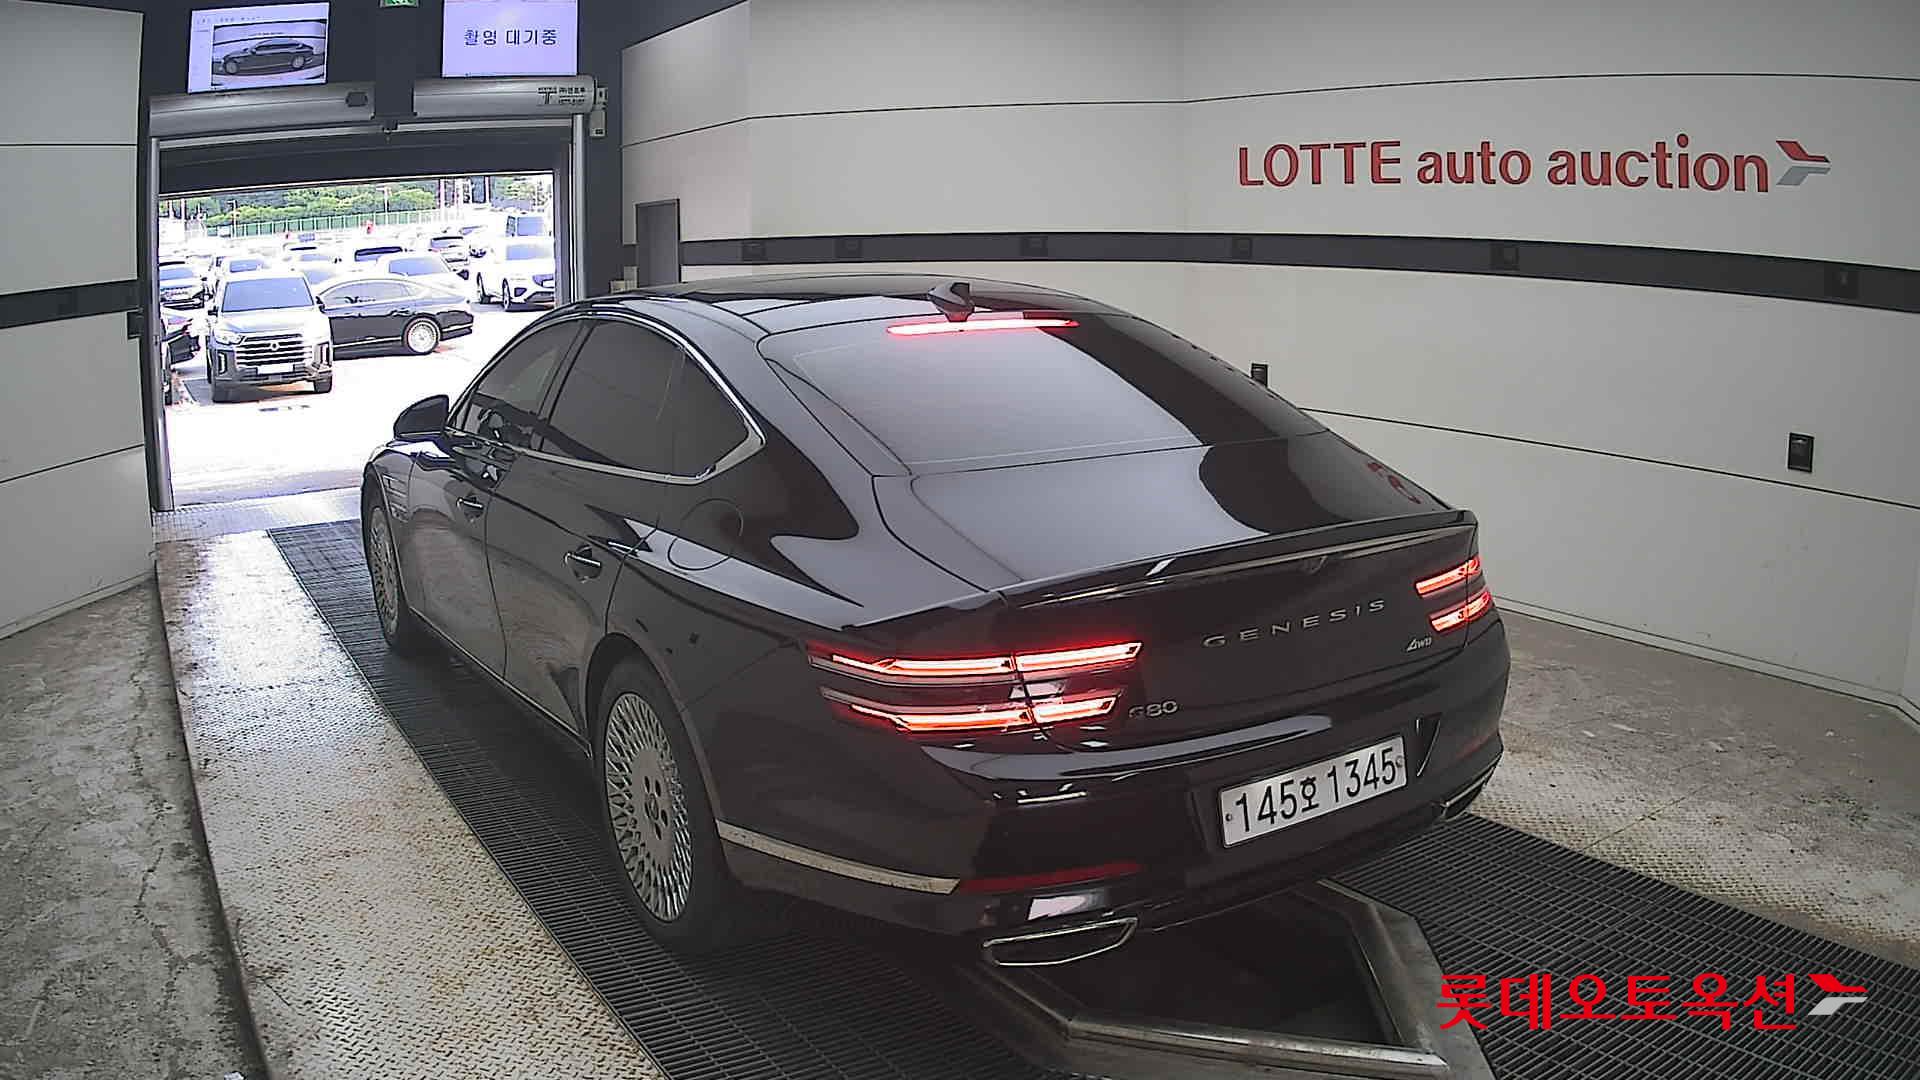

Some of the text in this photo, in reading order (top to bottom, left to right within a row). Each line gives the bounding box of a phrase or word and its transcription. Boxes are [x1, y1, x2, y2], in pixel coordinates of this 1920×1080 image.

[506, 29, 557, 46] 대기중
[1239, 133, 1769, 193] LOTTE auto auction
[1202, 599, 1386, 648] GENESIS
[1128, 700, 1178, 719] G80
[1235, 746, 1396, 833] 145호 1345
